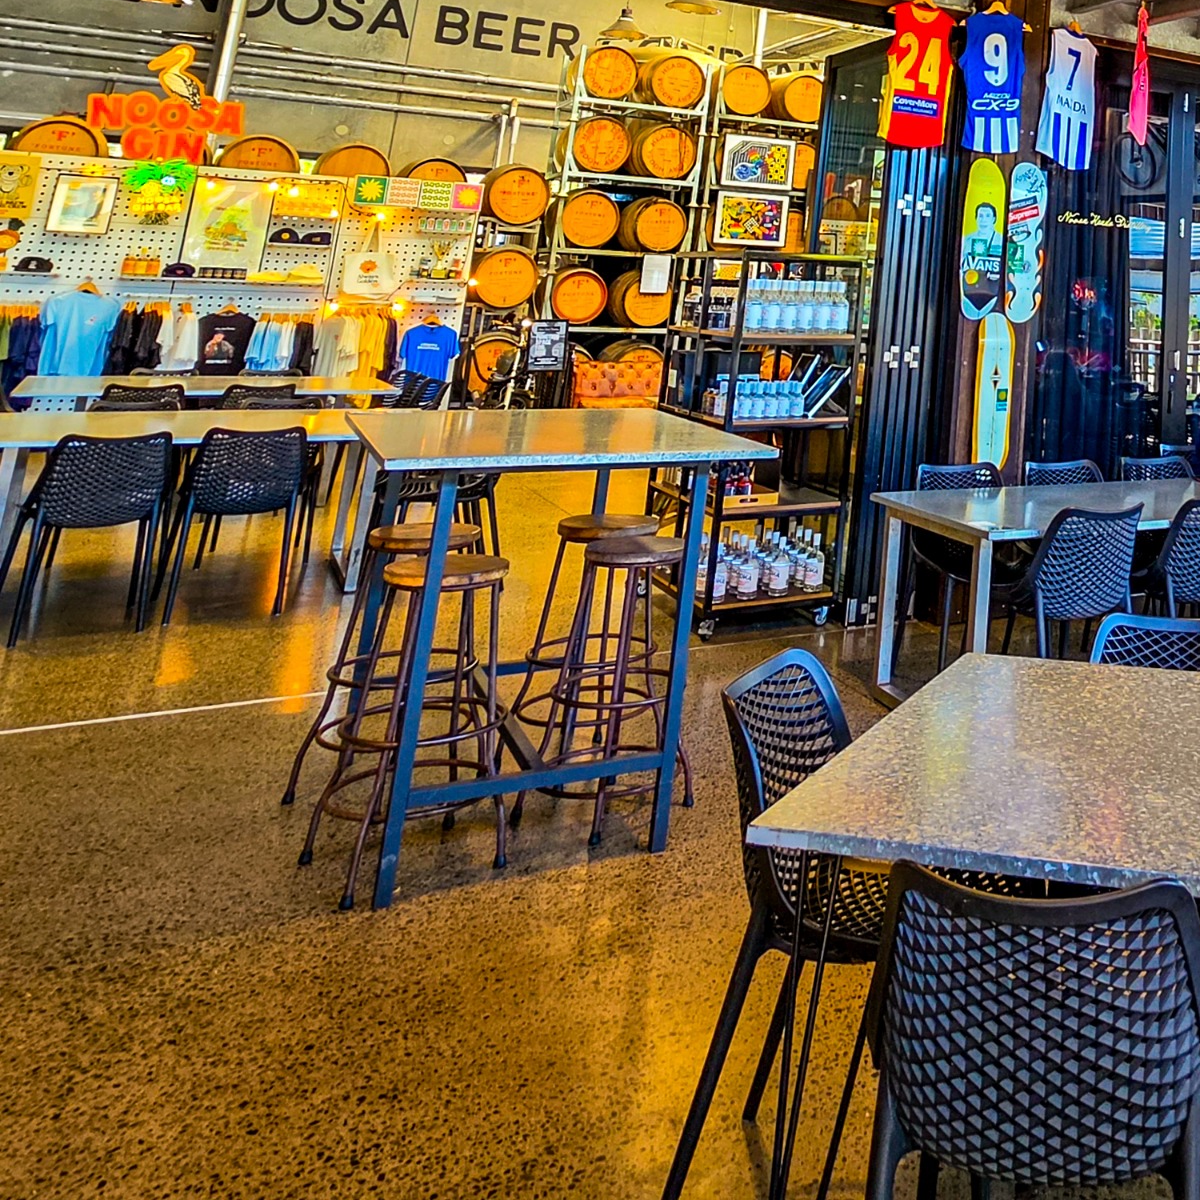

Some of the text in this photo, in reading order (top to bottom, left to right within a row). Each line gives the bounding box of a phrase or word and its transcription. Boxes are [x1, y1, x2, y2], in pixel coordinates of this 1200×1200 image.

[434, 5, 581, 60] BEER
[893, 31, 942, 96] 24
[983, 33, 1008, 87] 9
[1067, 47, 1082, 91] 7
[89, 93, 243, 135] NOOSA
[971, 99, 1020, 111] CX-9
[1056, 94, 1086, 115] MADA
[121, 127, 204, 165] GIN
[1009, 208, 1038, 222] Supreme
[969, 256, 1001, 273] VANS
